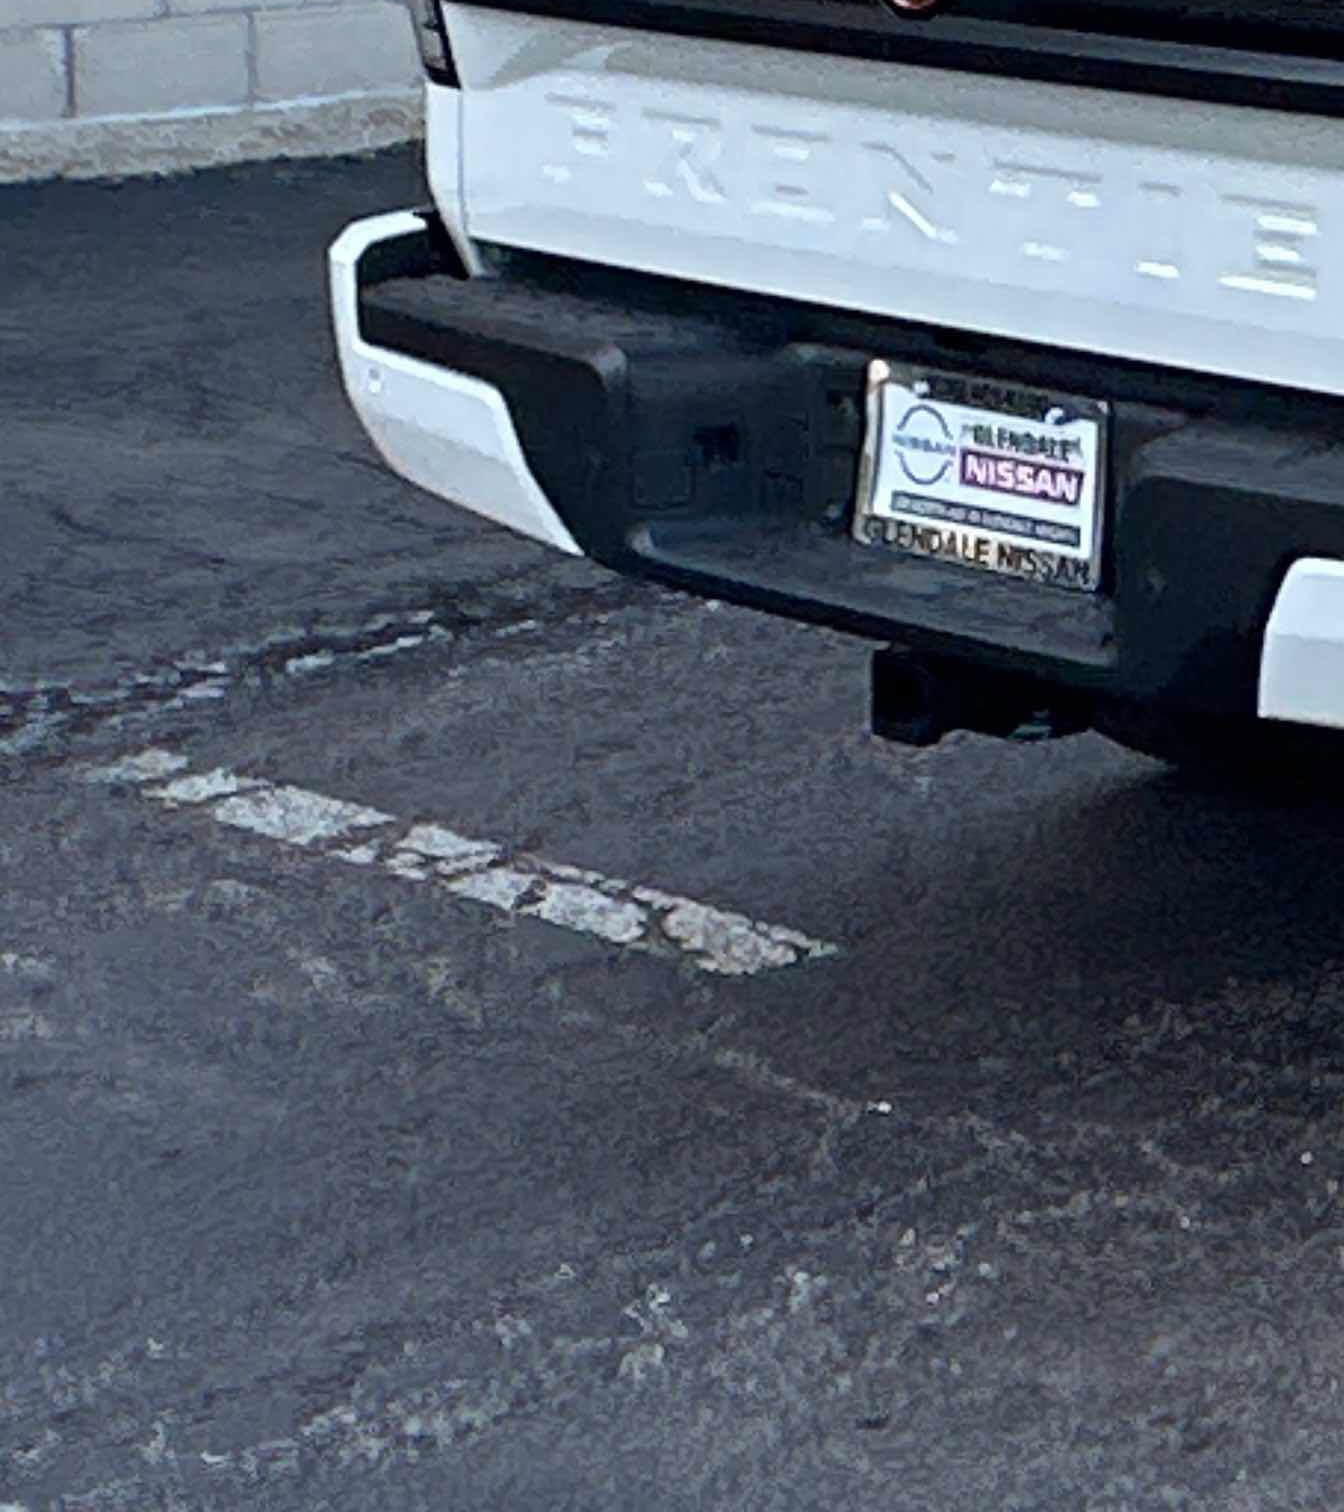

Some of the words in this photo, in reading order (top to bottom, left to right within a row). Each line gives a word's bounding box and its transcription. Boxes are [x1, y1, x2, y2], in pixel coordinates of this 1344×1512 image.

[965, 453, 1079, 503] NISSAN
[864, 515, 990, 567] GLENDALE
[996, 540, 1091, 586] NISSAN
